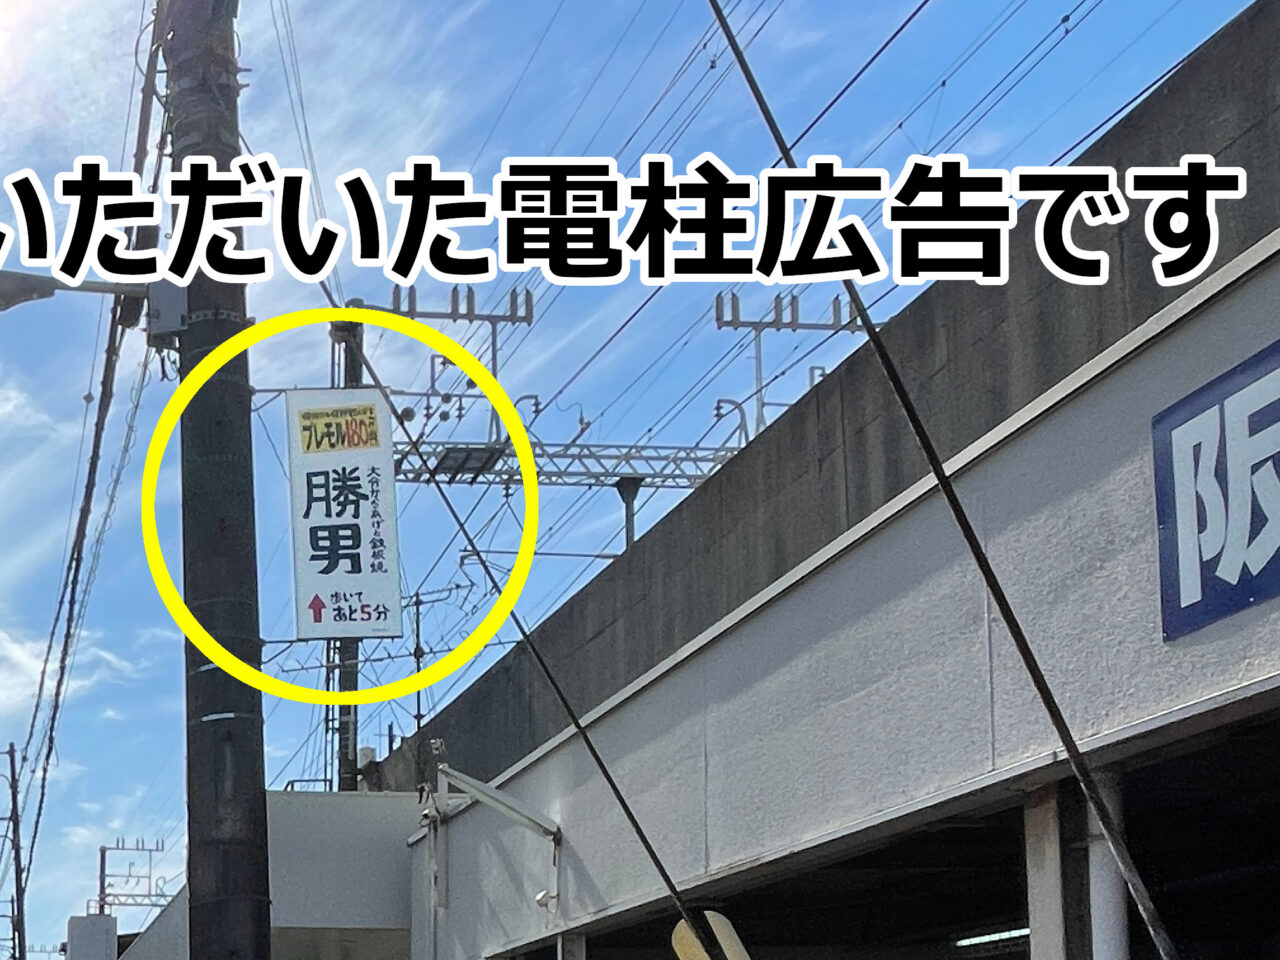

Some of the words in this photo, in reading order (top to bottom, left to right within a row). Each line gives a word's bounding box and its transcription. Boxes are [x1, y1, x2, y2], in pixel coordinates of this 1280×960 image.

[302, 466, 370, 575] 勝男
[332, 604, 390, 622] あと5分
